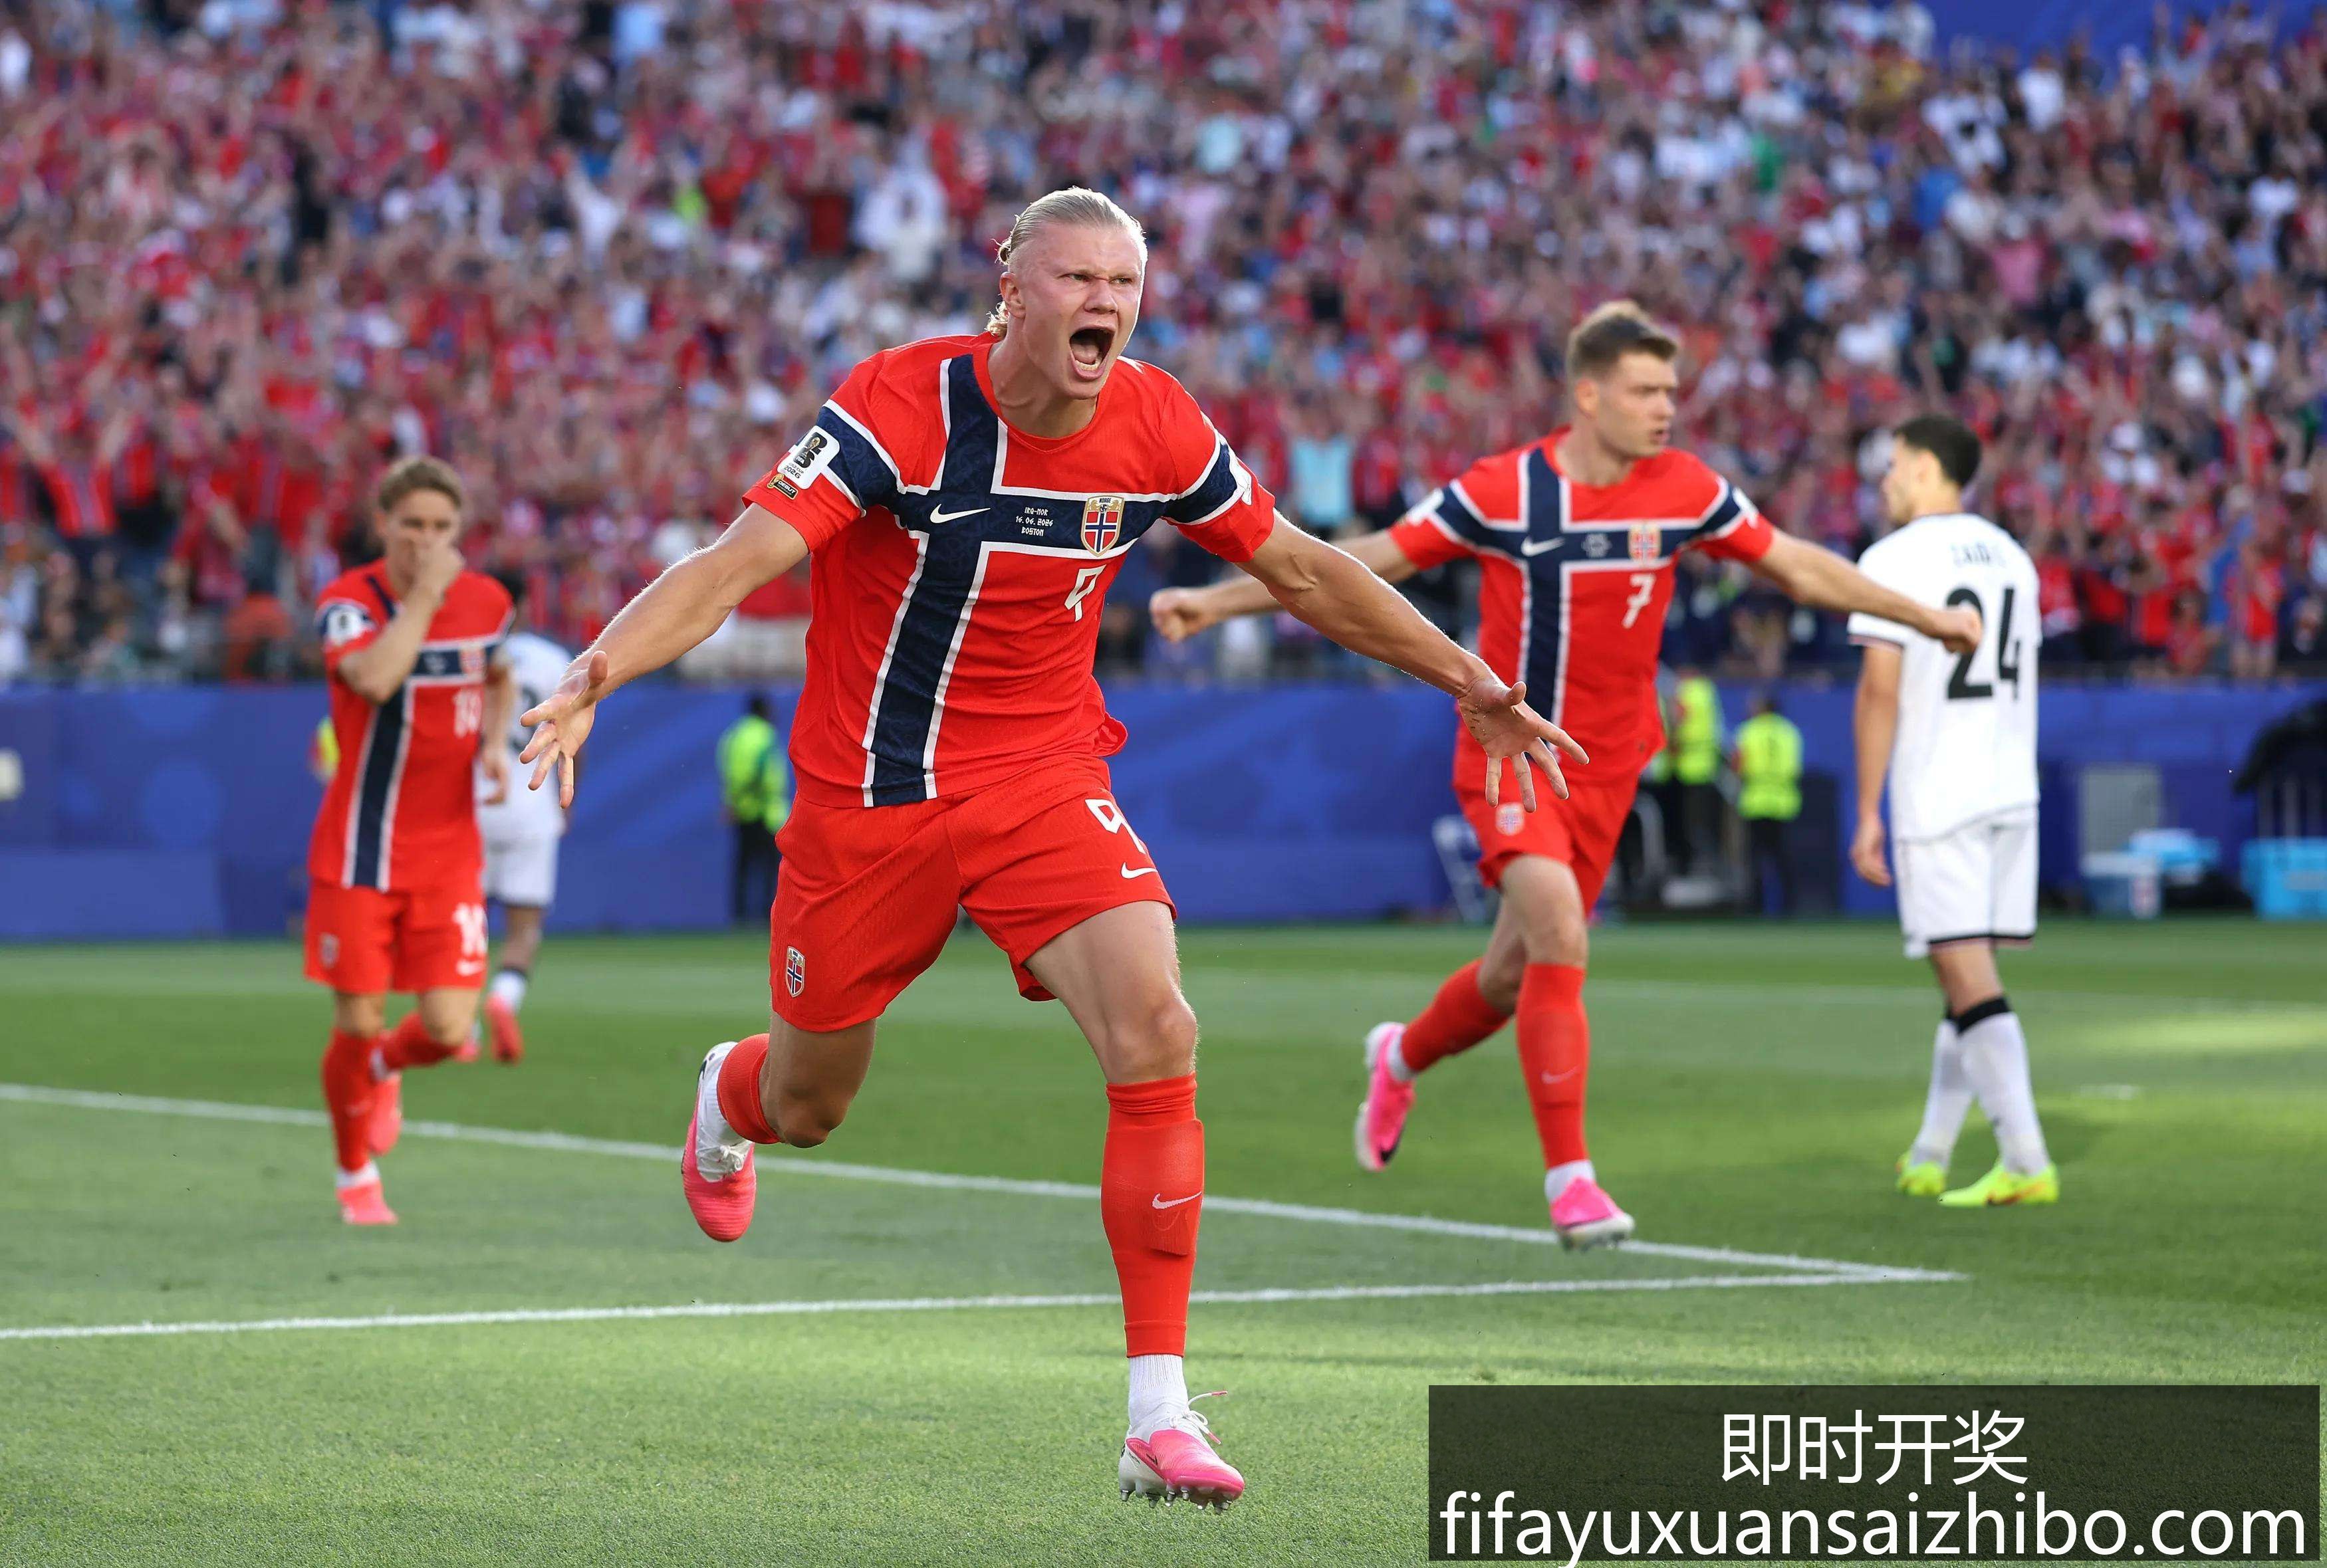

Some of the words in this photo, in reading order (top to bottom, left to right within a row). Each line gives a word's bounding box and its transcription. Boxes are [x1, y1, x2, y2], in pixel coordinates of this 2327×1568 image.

[778, 481, 796, 494] DEBUT
[784, 465, 801, 479] 2026
[1021, 526, 1044, 536] BOSTON
[1064, 564, 1107, 622] 9
[1622, 573, 1656, 629] 7
[1945, 588, 2021, 701] 24
[1085, 798, 1147, 855] 9
